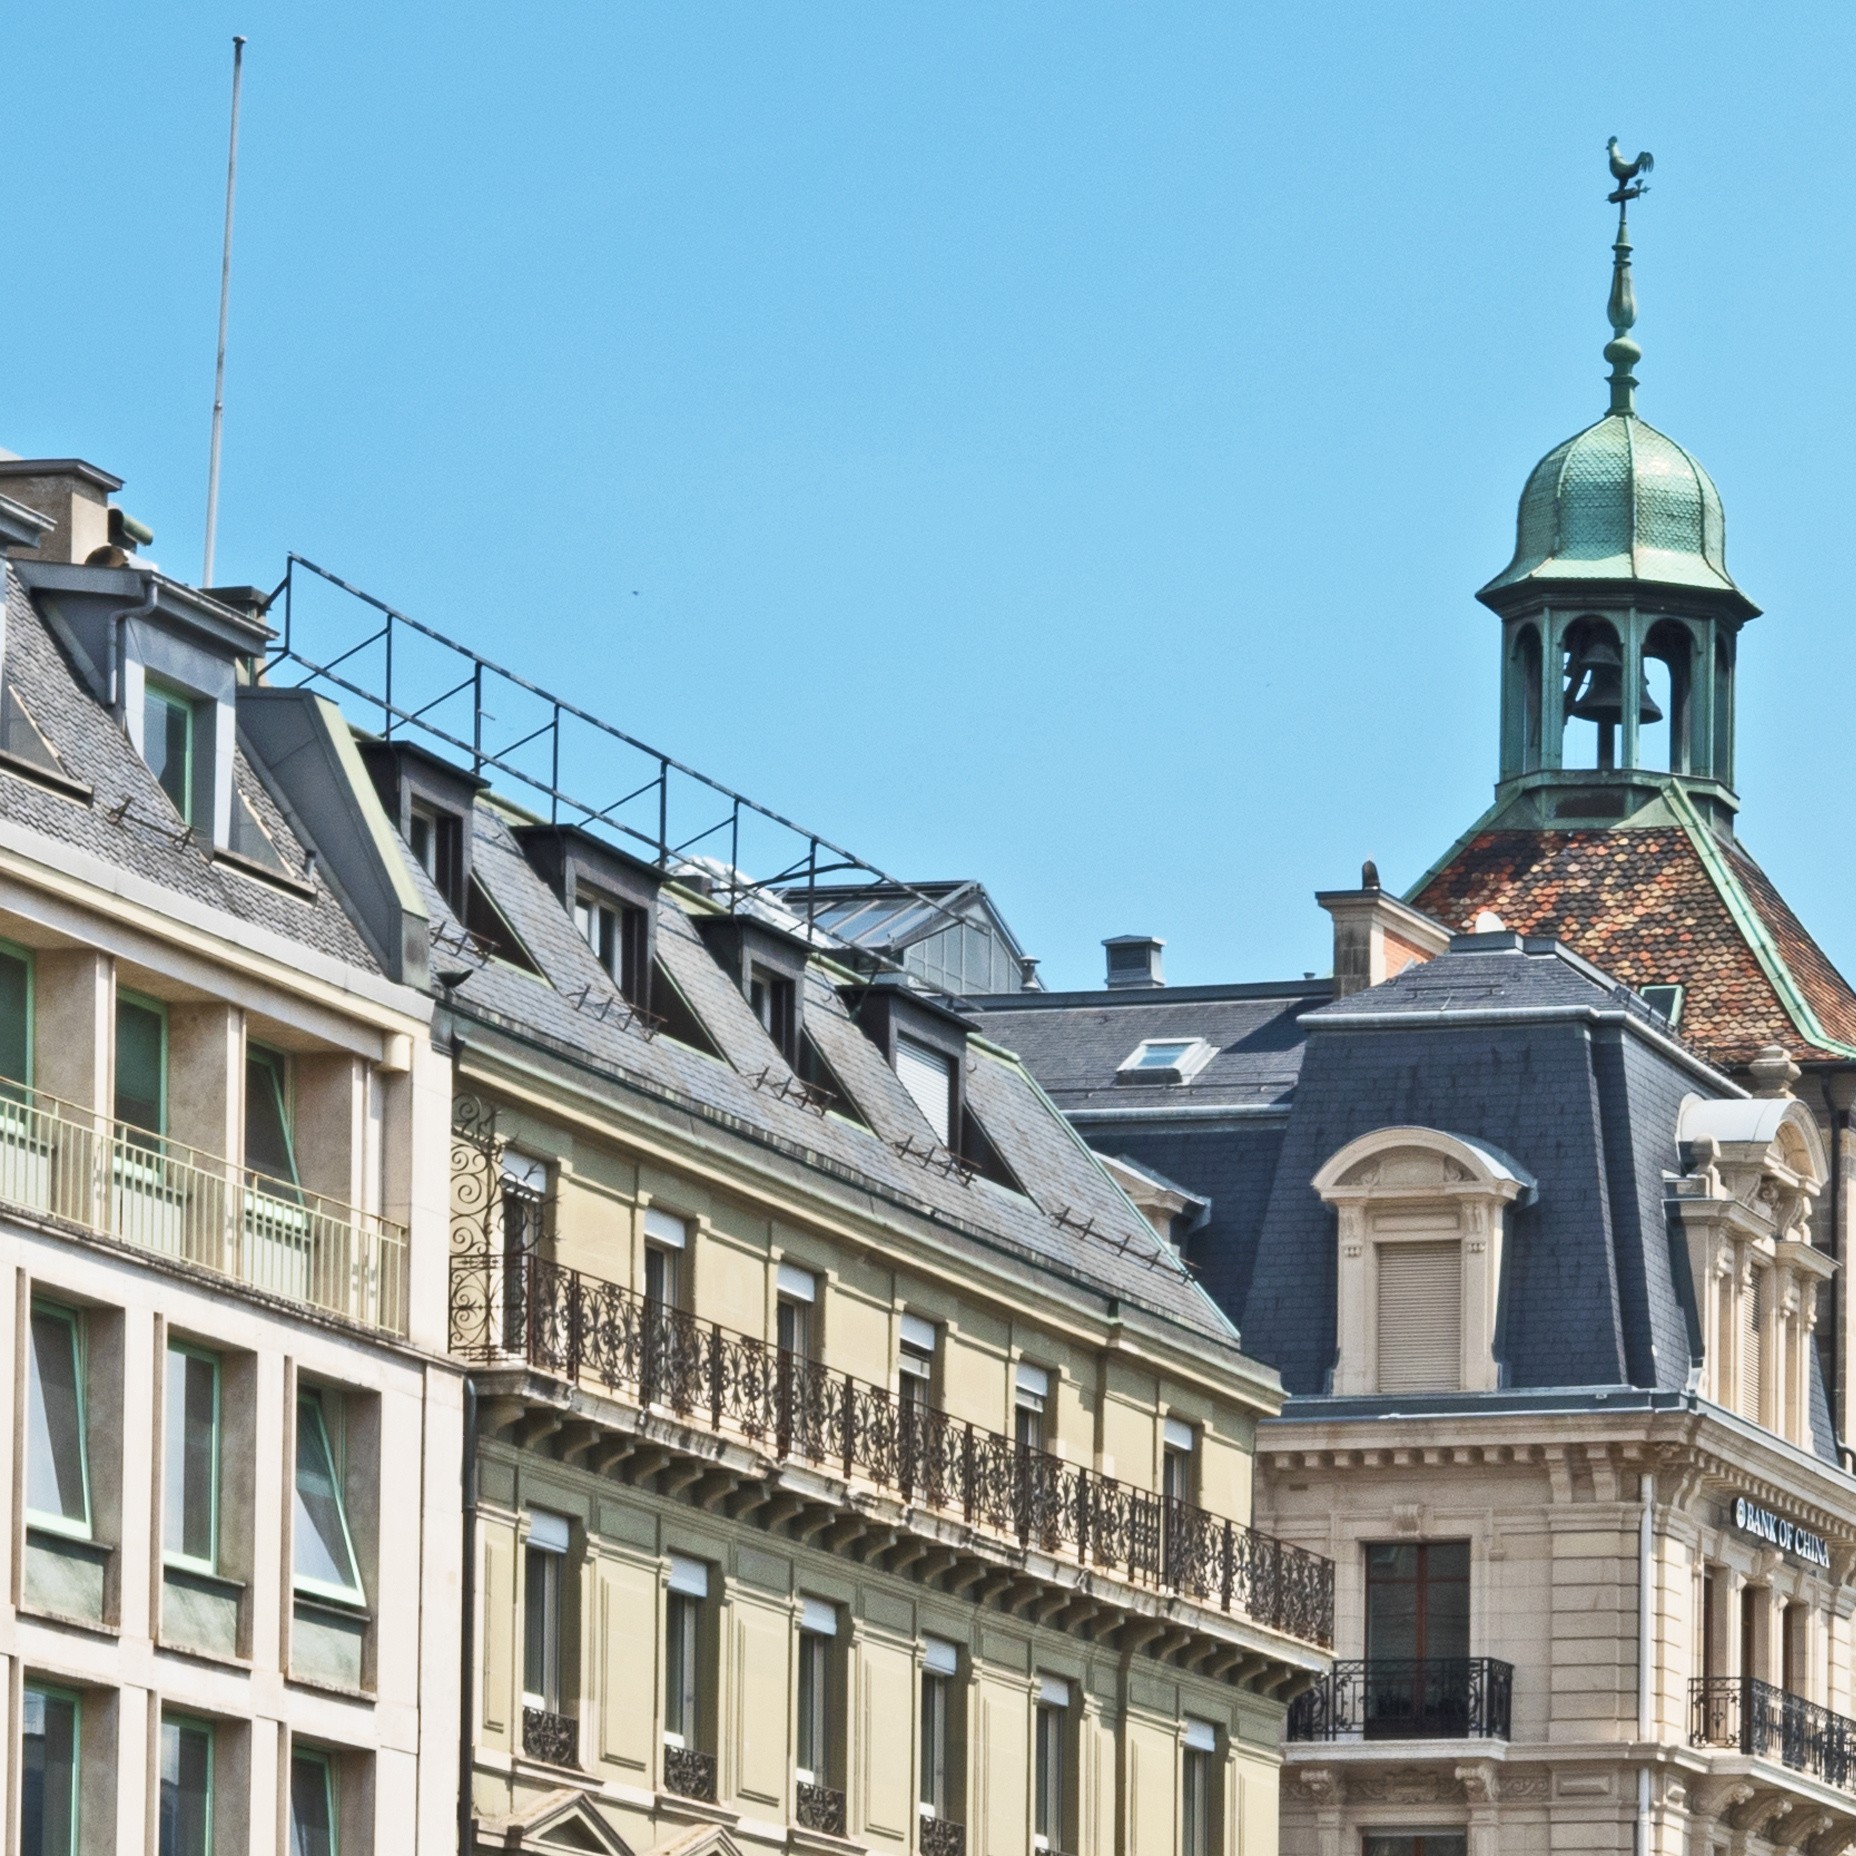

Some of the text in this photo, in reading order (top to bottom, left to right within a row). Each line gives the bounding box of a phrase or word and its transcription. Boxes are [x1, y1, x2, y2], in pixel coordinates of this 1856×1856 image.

[1746, 1502, 1831, 1569] BANK OF CHINA
